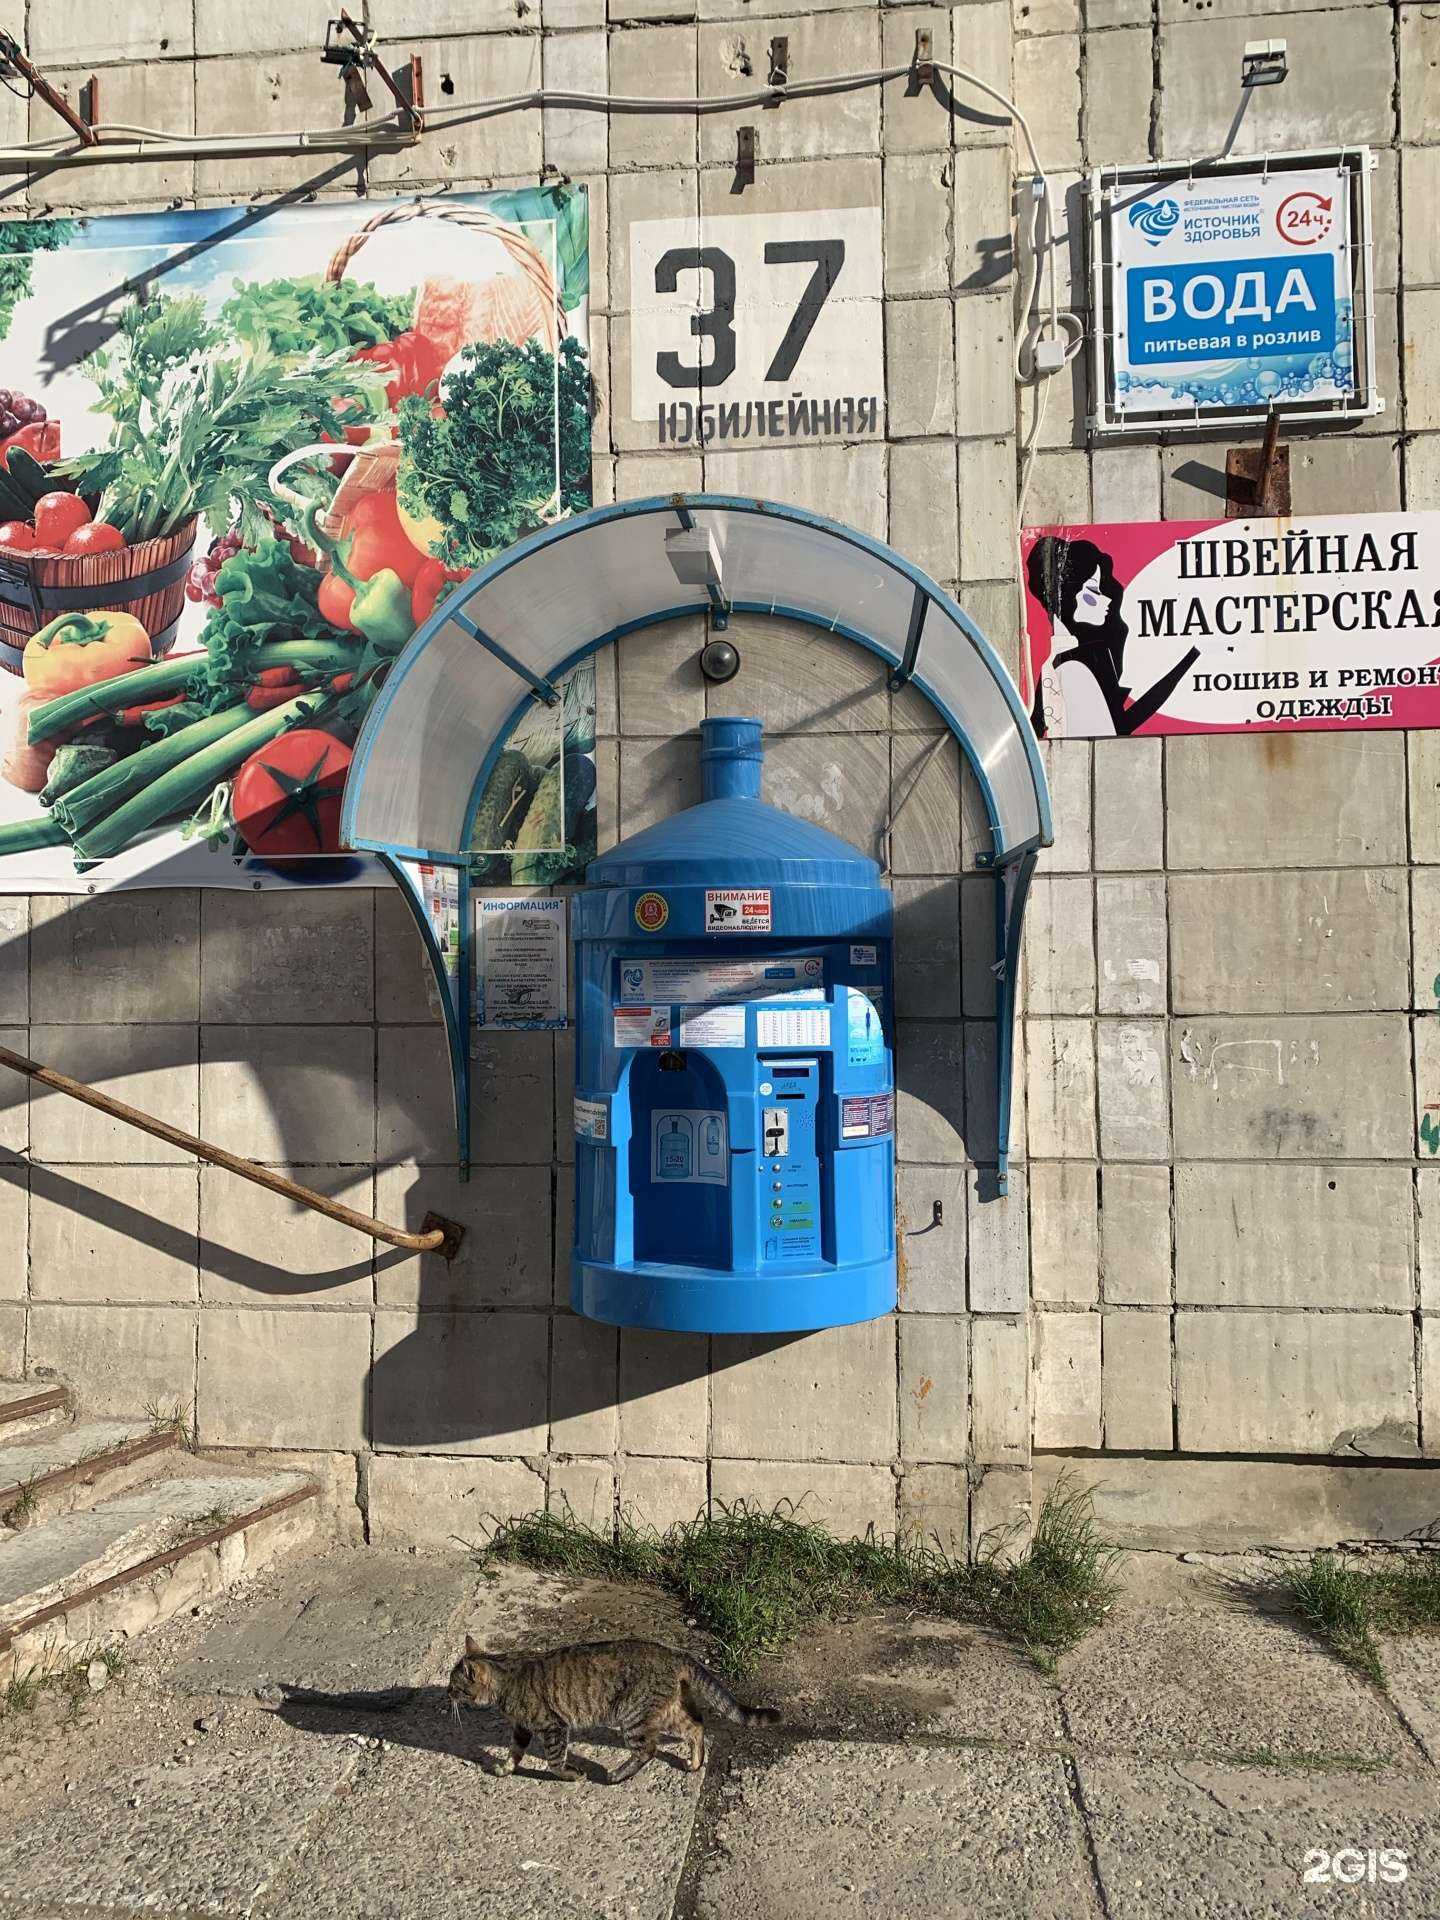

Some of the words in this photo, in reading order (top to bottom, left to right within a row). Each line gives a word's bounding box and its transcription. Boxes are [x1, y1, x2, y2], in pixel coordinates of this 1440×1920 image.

[1184, 196, 1239, 206] ФЕДЕРАЛЬНАЯ
[1184, 213, 1260, 229] ИСТОЧНИК
[1184, 227, 1261, 243] ЗДОРОВЬЯ
[1143, 268, 1317, 324] ВОДА
[655, 239, 845, 388] 37
[1144, 335, 1231, 353] питьевая
[1236, 335, 1248, 347] в
[1253, 329, 1321, 349] розлив
[658, 392, 877, 443] ЮБИЛЕЙНАЯ
[1177, 529, 1419, 579] ШВЕЙНАЯ
[1193, 671, 1299, 692] ПОШИВ
[1308, 670, 1328, 689] И
[1338, 666, 1440, 688] РЕМОН
[1256, 697, 1391, 720] ОДЕЖДЫ
[483, 901, 559, 911] ИНФОРМАЦИЯ
[707, 892, 769, 902] ВНИМАНИЕ
[744, 905, 754, 914] 24
